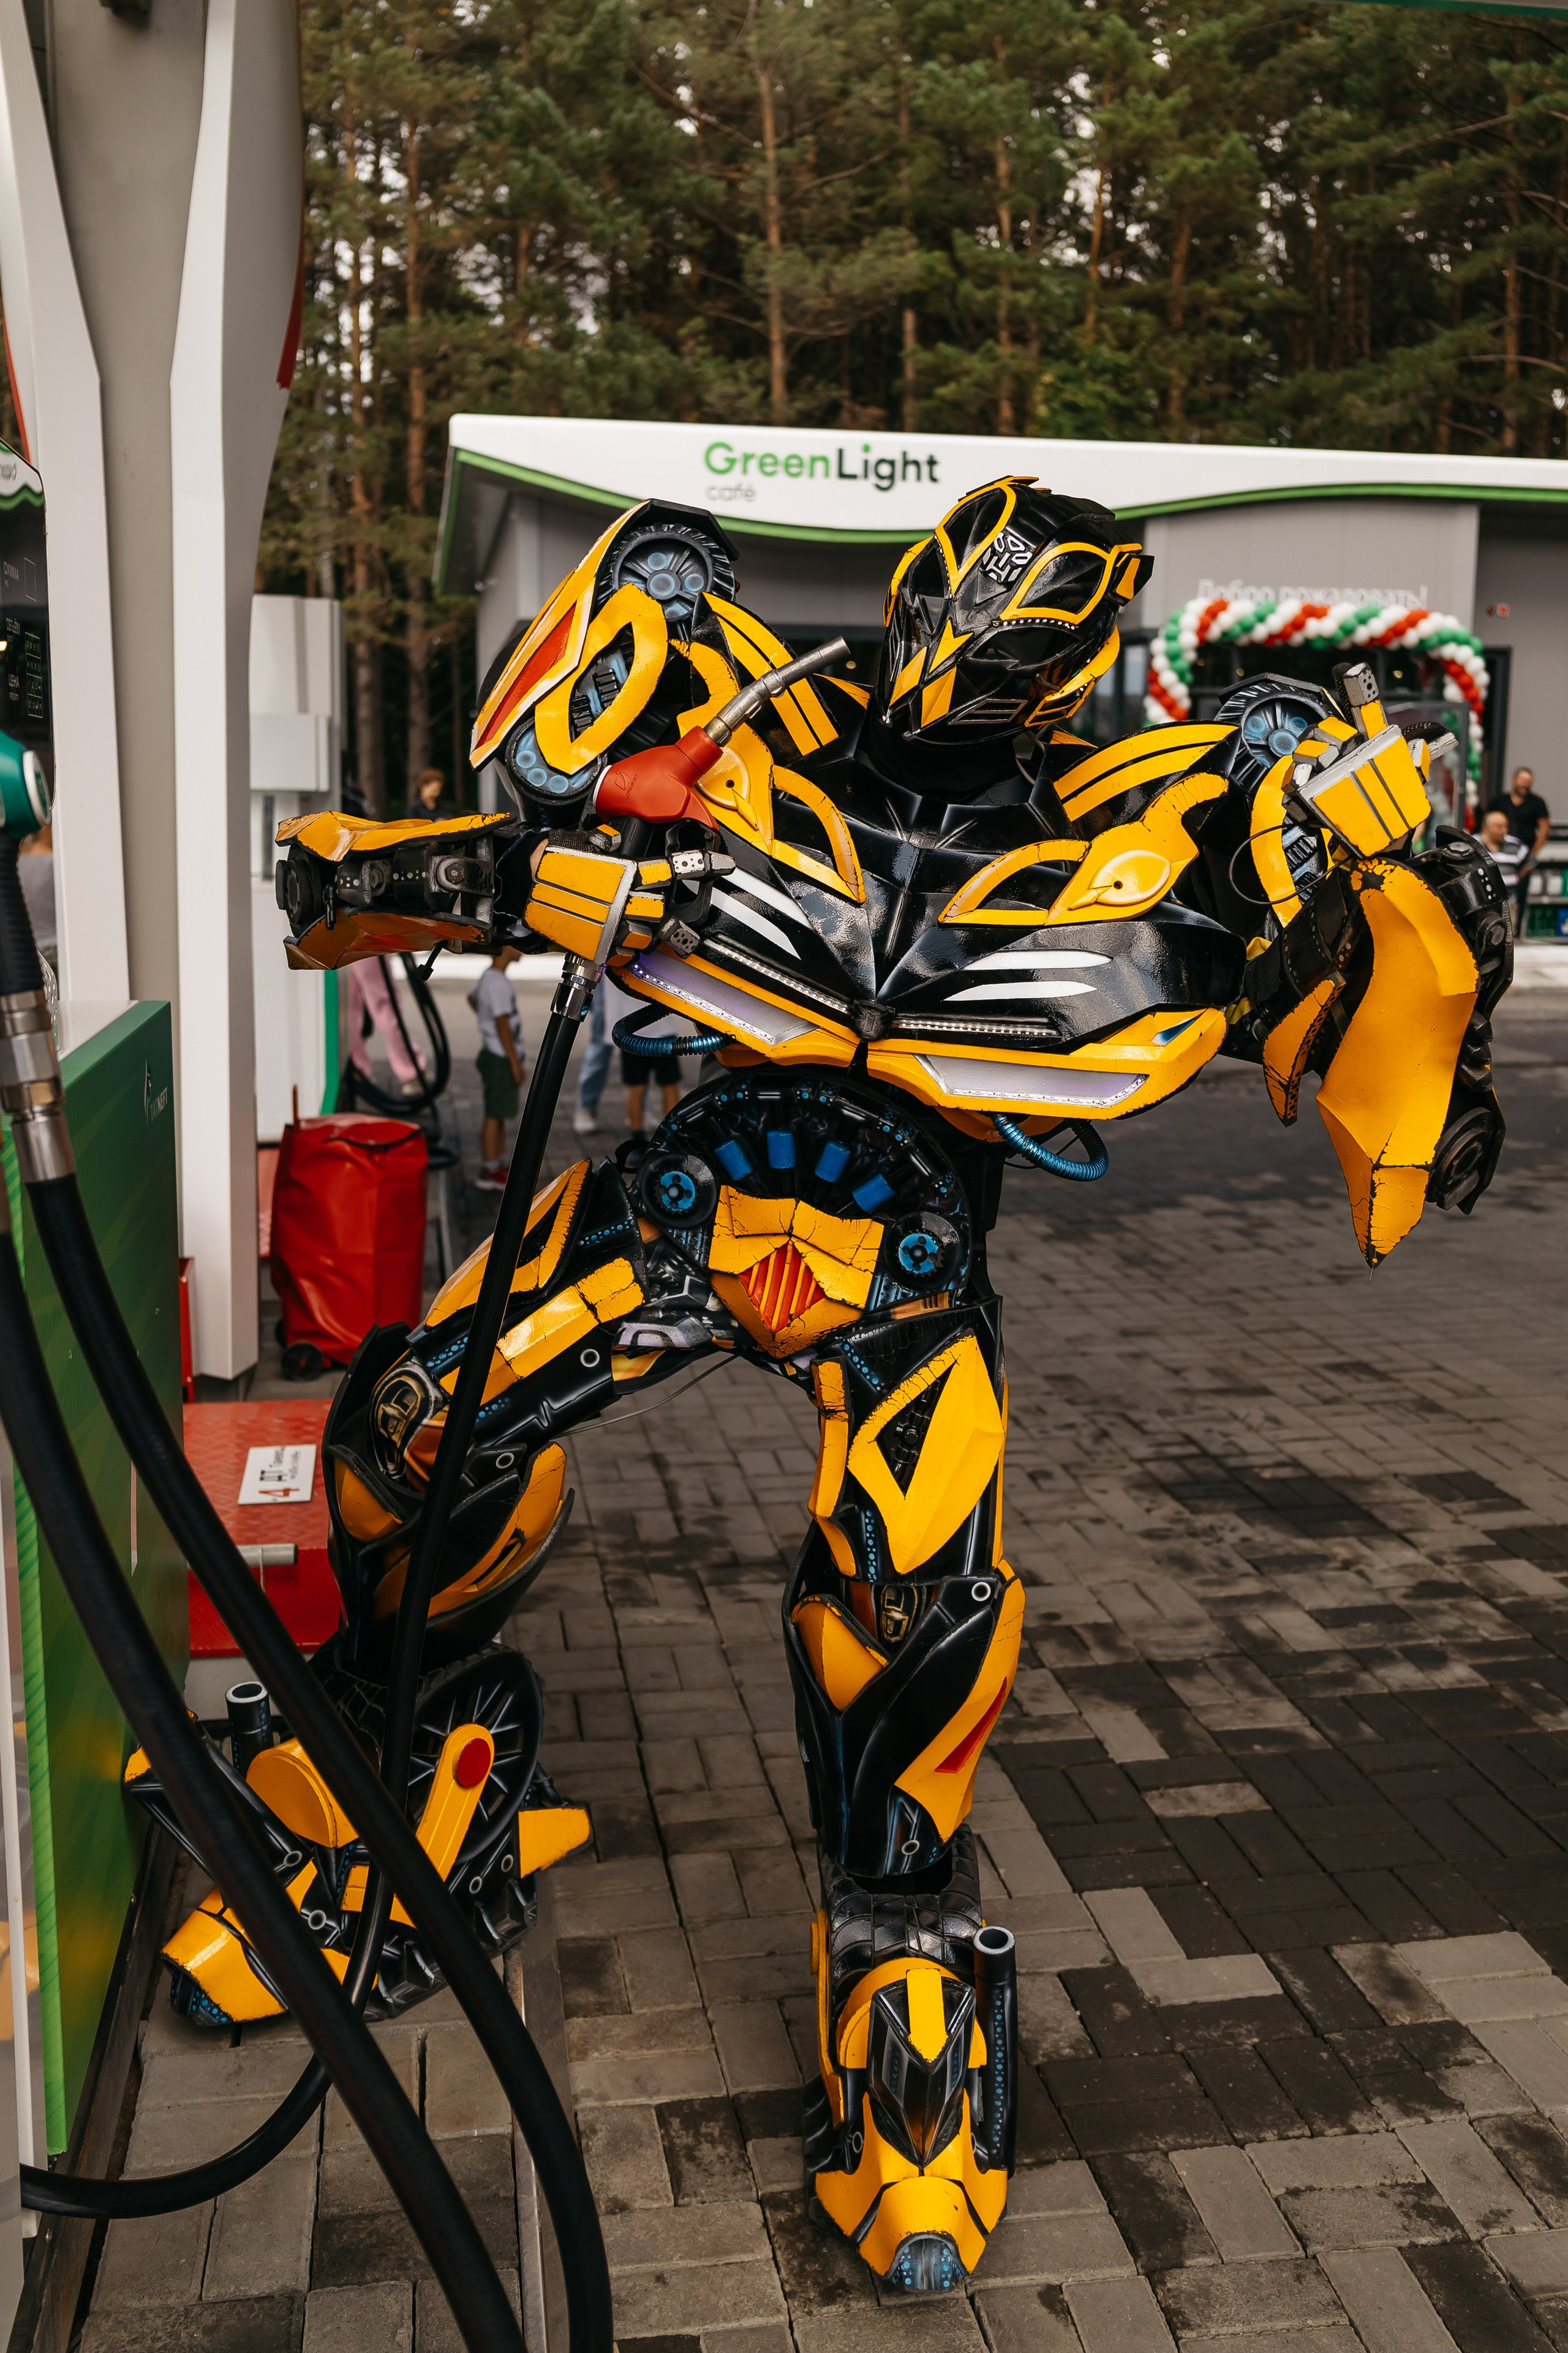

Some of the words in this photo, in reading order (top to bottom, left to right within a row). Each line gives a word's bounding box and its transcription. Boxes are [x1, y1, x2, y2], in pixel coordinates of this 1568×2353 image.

[704, 442, 939, 491] GreenLight
[706, 482, 757, 502] café
[150, 1087, 168, 1122] TATNEFT
